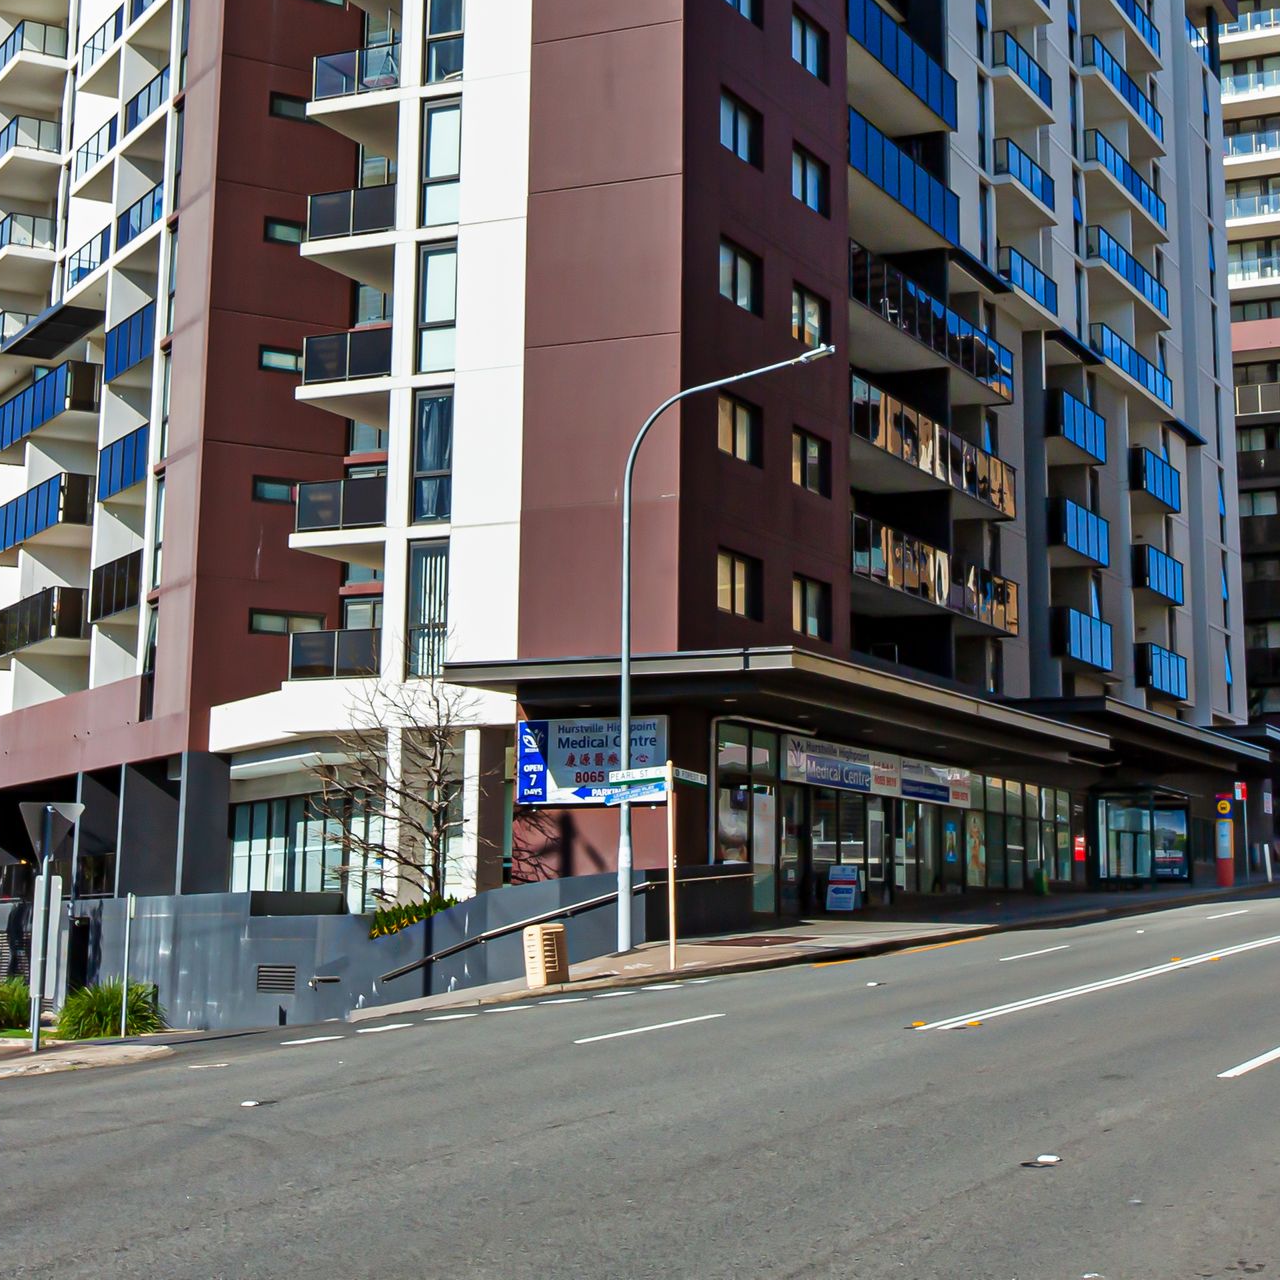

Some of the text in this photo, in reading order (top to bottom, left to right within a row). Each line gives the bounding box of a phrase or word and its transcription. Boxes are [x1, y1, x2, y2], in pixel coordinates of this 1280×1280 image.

[558, 721, 656, 735] Hurstville Higpoint
[558, 734, 657, 749] Medical Cntre
[523, 764, 544, 772] OPEN
[807, 759, 840, 782] Medical
[843, 767, 870, 787] Centre
[529, 773, 537, 786] 7
[575, 771, 605, 783] 8065
[610, 771, 636, 781] PEARL
[640, 769, 648, 778] ST
[523, 788, 543, 796] DAYS
